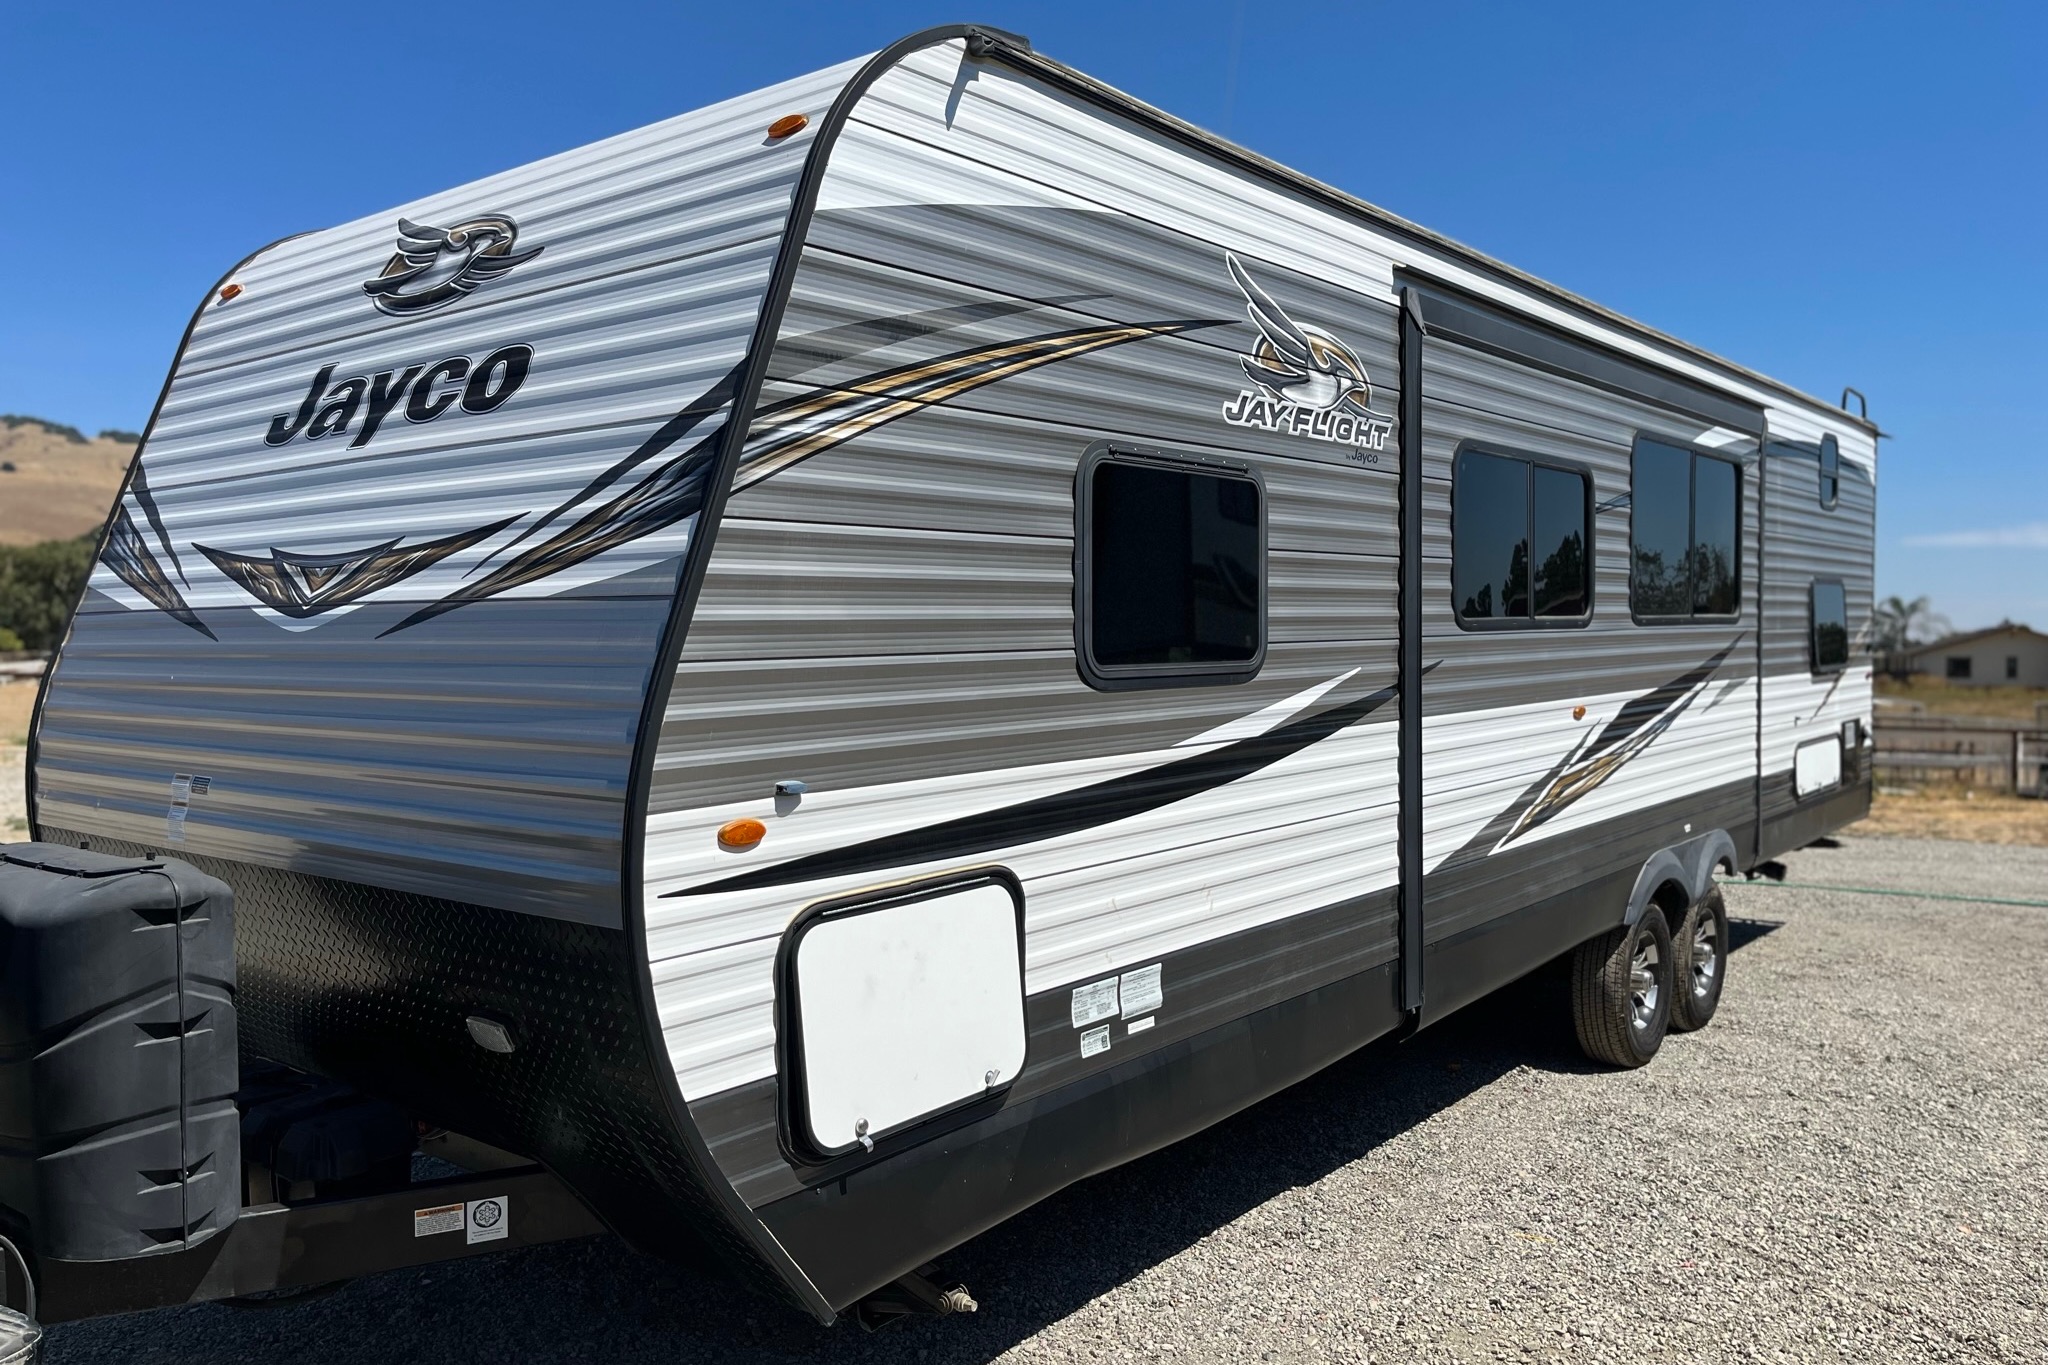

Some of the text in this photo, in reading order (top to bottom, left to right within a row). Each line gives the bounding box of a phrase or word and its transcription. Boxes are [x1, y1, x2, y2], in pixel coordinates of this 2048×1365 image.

[264, 343, 535, 450] Jayco
[1222, 390, 1393, 450] JAY FLIGHT
[1351, 448, 1379, 465] Jayco
